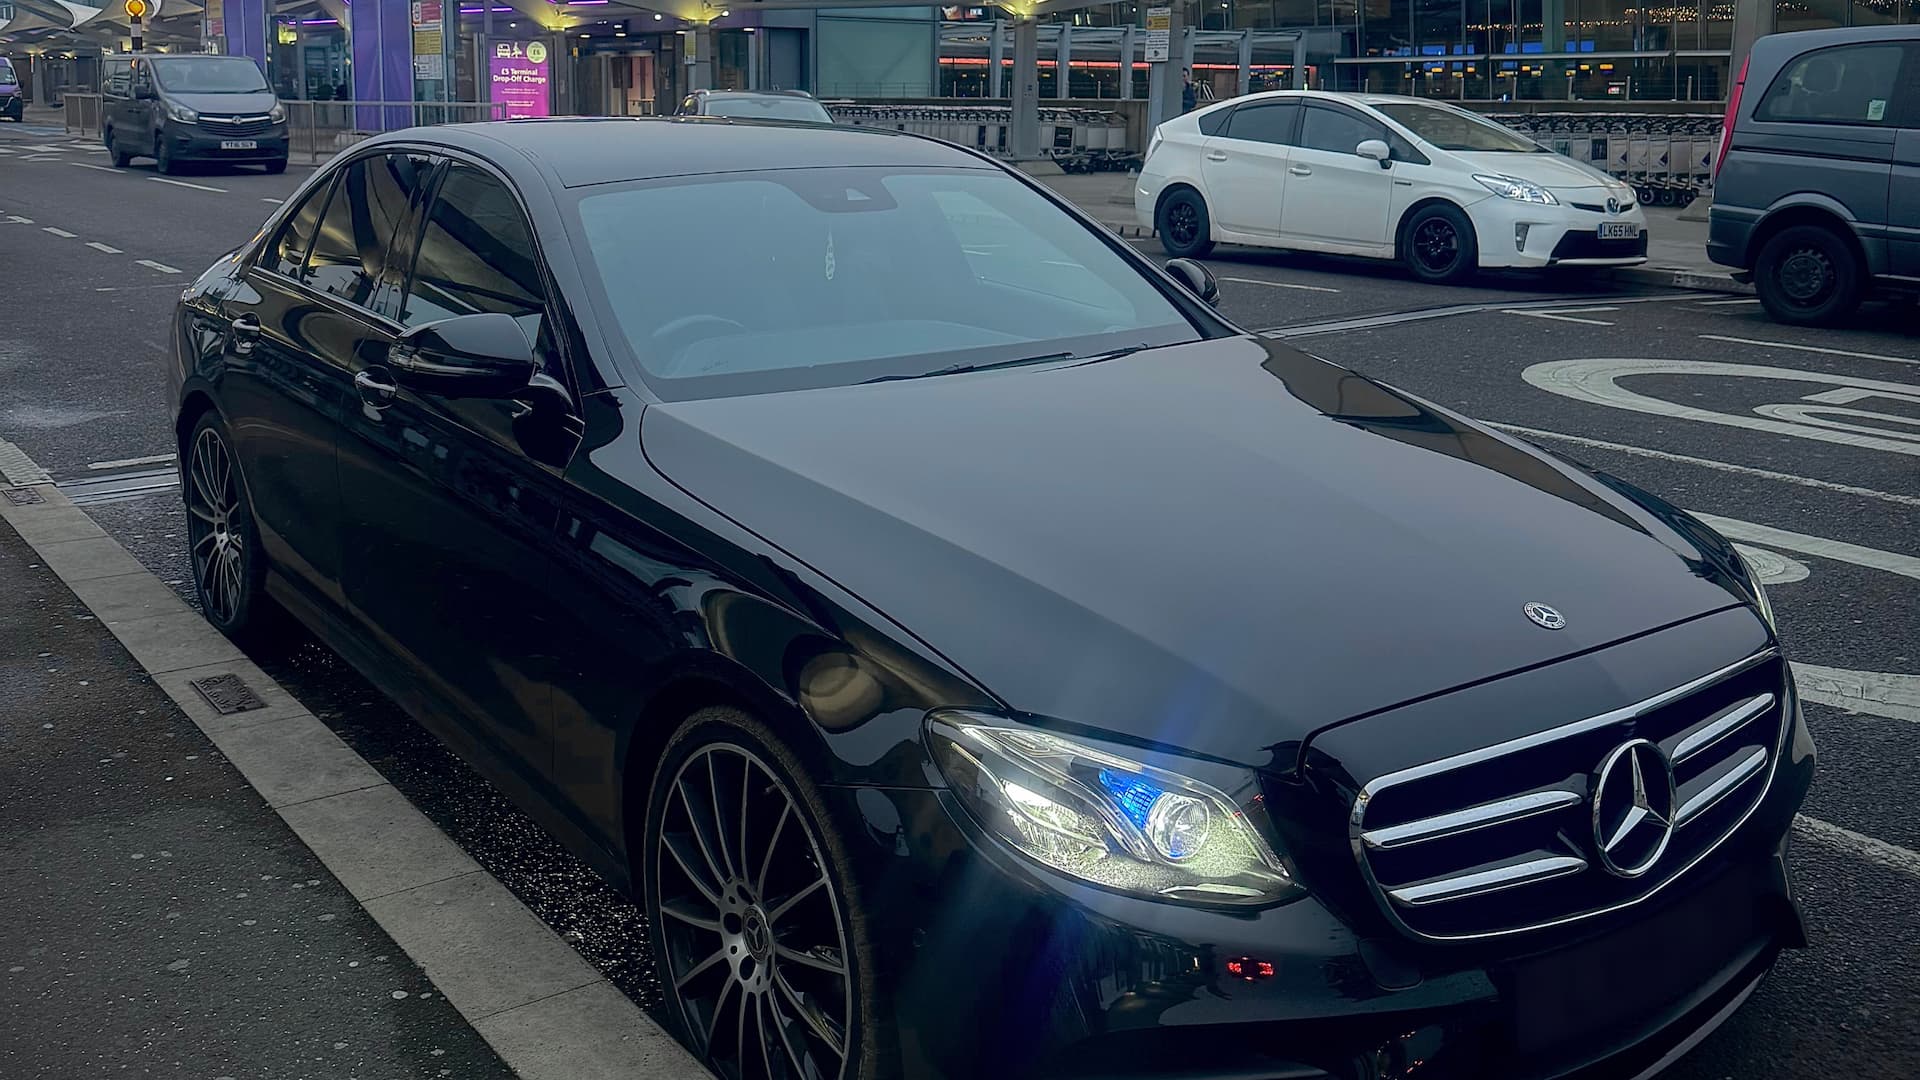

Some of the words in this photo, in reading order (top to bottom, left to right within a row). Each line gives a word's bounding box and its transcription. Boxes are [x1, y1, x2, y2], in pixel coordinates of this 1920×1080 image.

[511, 68, 538, 76] Terminal
[493, 75, 522, 83] Drop-Off
[523, 75, 546, 84] Charge
[1603, 225, 1623, 237] LK65
